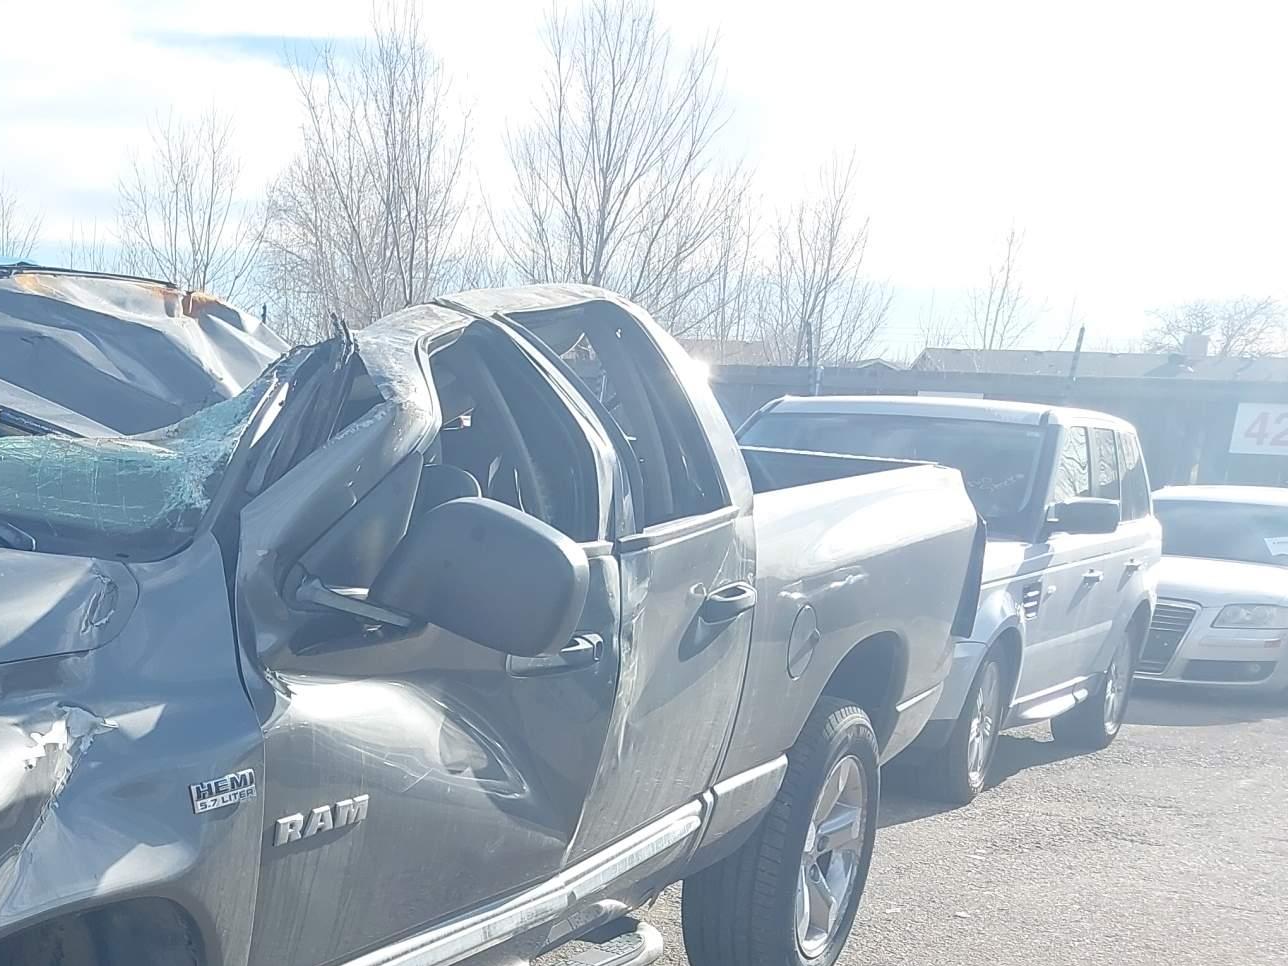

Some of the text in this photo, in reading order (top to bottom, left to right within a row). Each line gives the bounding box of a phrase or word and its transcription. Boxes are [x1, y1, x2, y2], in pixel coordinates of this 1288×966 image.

[196, 769, 255, 799] HEMI
[199, 788, 254, 811] 5.7 LITER
[272, 794, 370, 847] RAM
